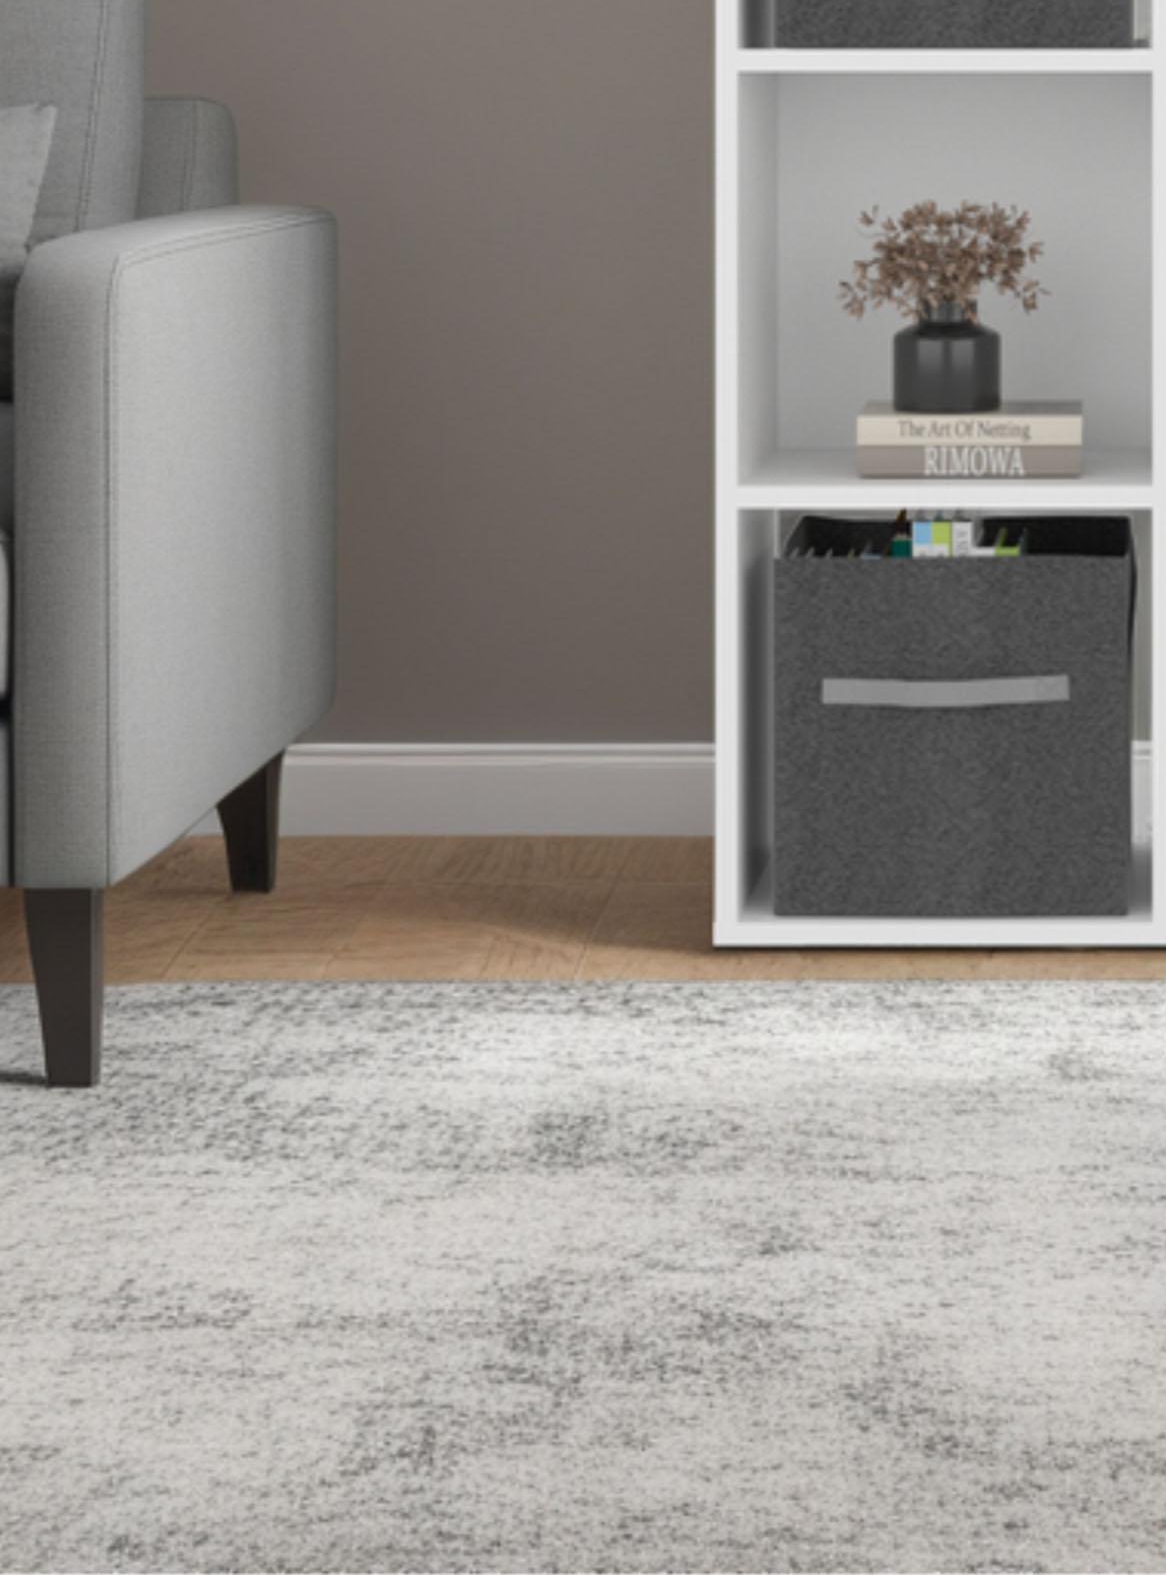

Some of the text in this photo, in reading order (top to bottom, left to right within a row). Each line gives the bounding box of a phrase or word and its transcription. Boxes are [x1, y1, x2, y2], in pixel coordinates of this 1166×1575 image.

[898, 420, 1032, 442] The Art Of Netting
[923, 446, 1026, 476] RIMOWA
